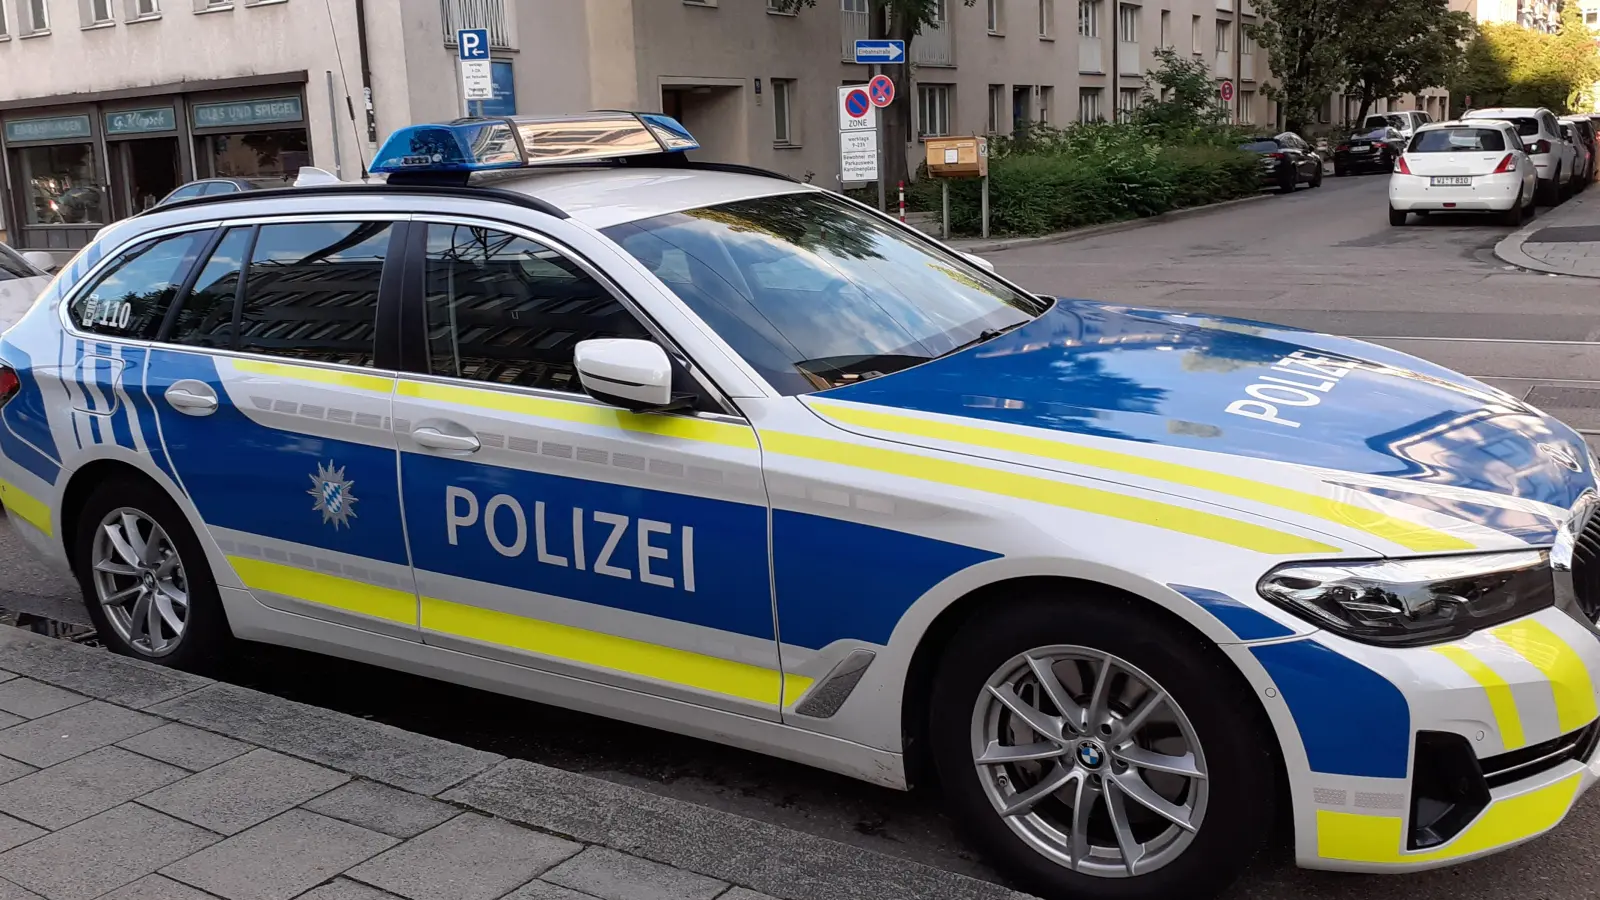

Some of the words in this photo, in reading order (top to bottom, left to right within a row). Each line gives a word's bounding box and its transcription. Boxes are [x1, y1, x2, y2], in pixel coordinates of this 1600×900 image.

[462, 33, 479, 56] P
[254, 102, 296, 117] SPIEGEL
[848, 118, 868, 128] ZONE
[99, 300, 131, 329] 110
[446, 485, 696, 592] POLIZEI
